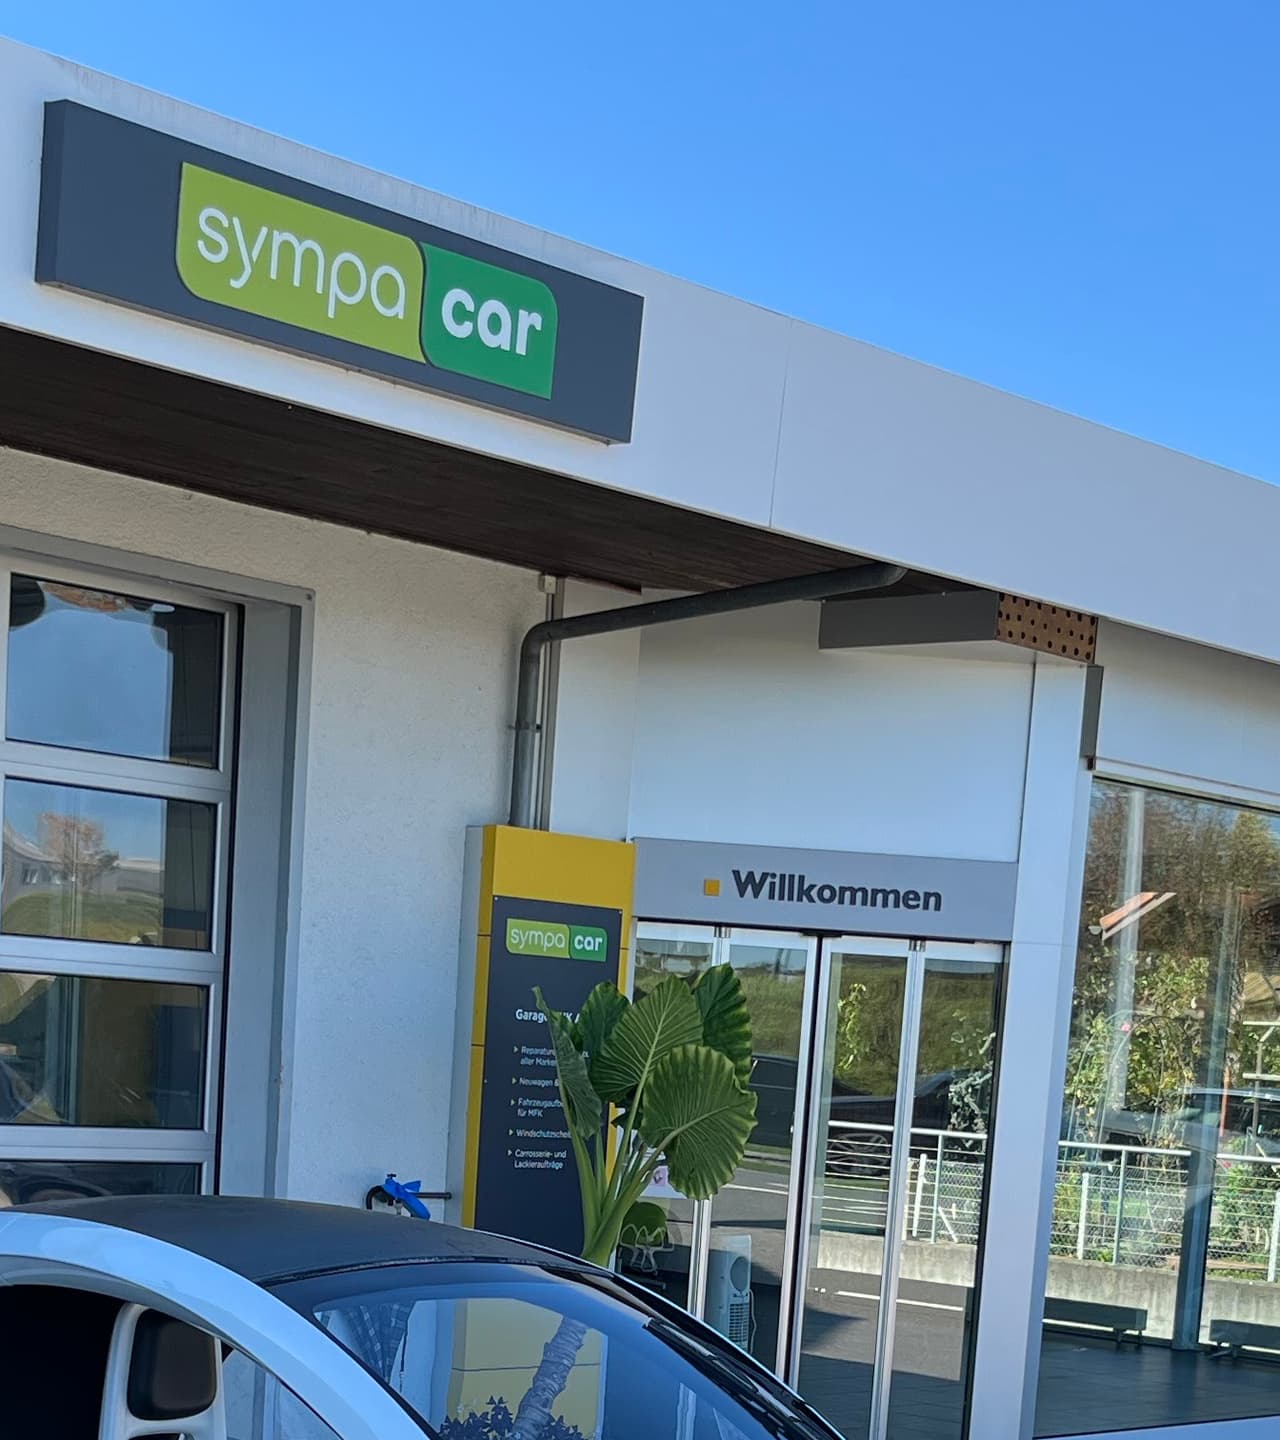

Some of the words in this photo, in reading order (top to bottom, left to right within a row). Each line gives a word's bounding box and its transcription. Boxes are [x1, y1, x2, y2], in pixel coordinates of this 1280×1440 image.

[196, 206, 407, 321] sympa
[441, 287, 544, 357] car
[731, 868, 942, 912] Willkommen
[510, 928, 566, 952] sympa
[574, 935, 603, 951] car
[554, 1149, 567, 1159] und
